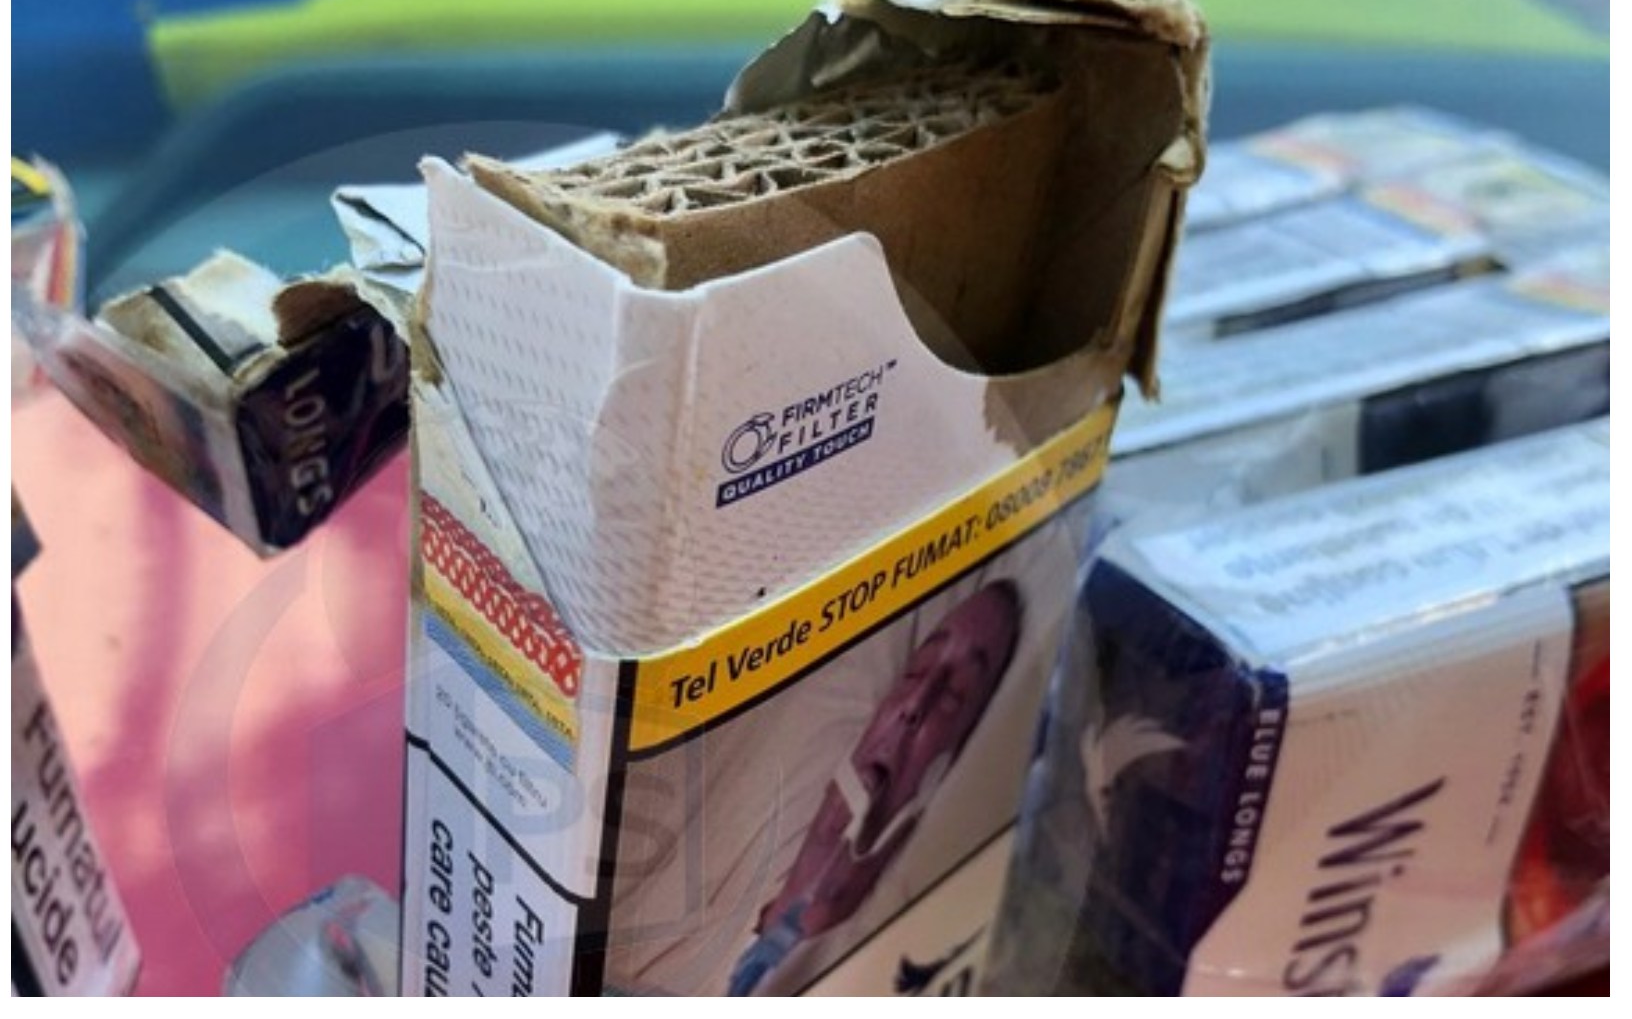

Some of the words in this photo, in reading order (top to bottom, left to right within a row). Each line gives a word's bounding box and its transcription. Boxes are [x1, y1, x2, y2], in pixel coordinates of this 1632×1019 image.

[285, 368, 334, 516] LONGS
[777, 393, 878, 454] FILTER
[783, 365, 883, 428] FIRMTECH
[722, 455, 806, 500] QUALITY
[814, 425, 870, 462] TOUCH
[671, 662, 716, 708] Tel
[727, 620, 812, 679] Verde
[818, 571, 886, 633] STOP
[892, 519, 981, 587] FUMAT:
[1245, 708, 1280, 779] BLUE
[24, 700, 123, 966] Fumatul
[429, 818, 454, 915] care
[1221, 792, 1260, 884] LONGS
[1282, 776, 1446, 996] Wins
[11, 801, 79, 985] ucide
[468, 851, 498, 979] peste
